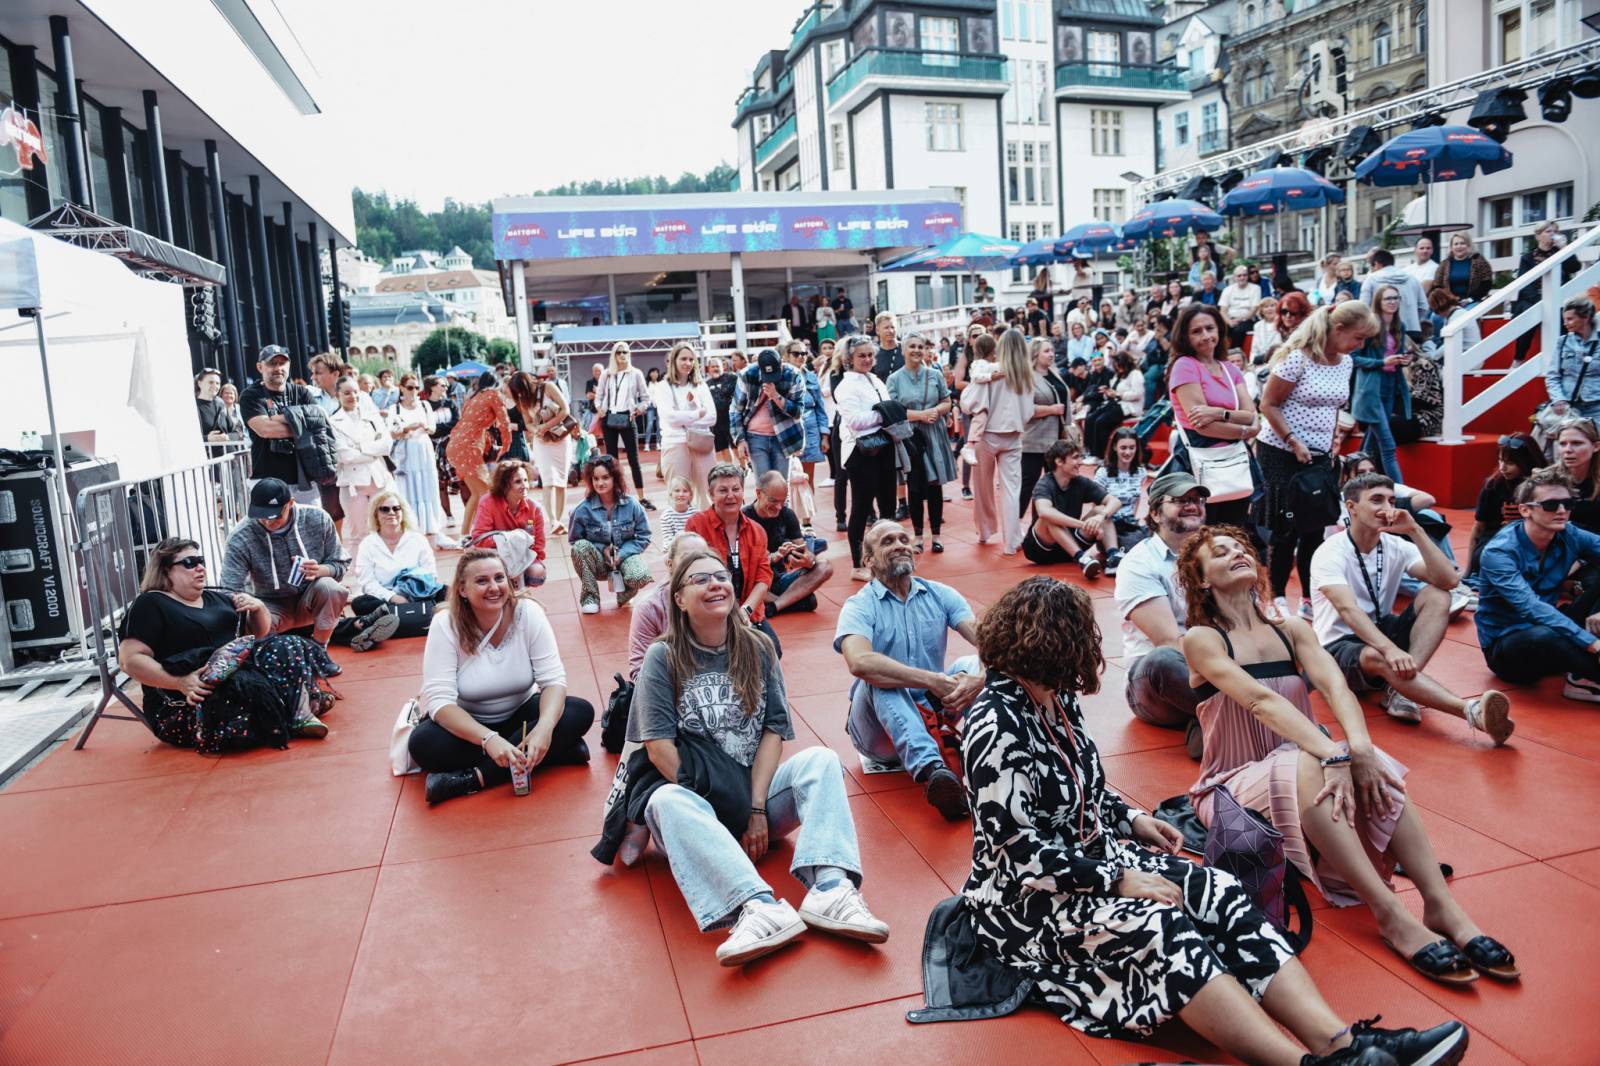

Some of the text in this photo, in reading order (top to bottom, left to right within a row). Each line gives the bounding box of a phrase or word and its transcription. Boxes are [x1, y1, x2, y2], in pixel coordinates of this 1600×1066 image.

[558, 227, 595, 239] LIFE
[701, 224, 737, 235] LIFE
[837, 219, 872, 231] LIFE
[31, 498, 53, 570] SOUNDCRAFT
